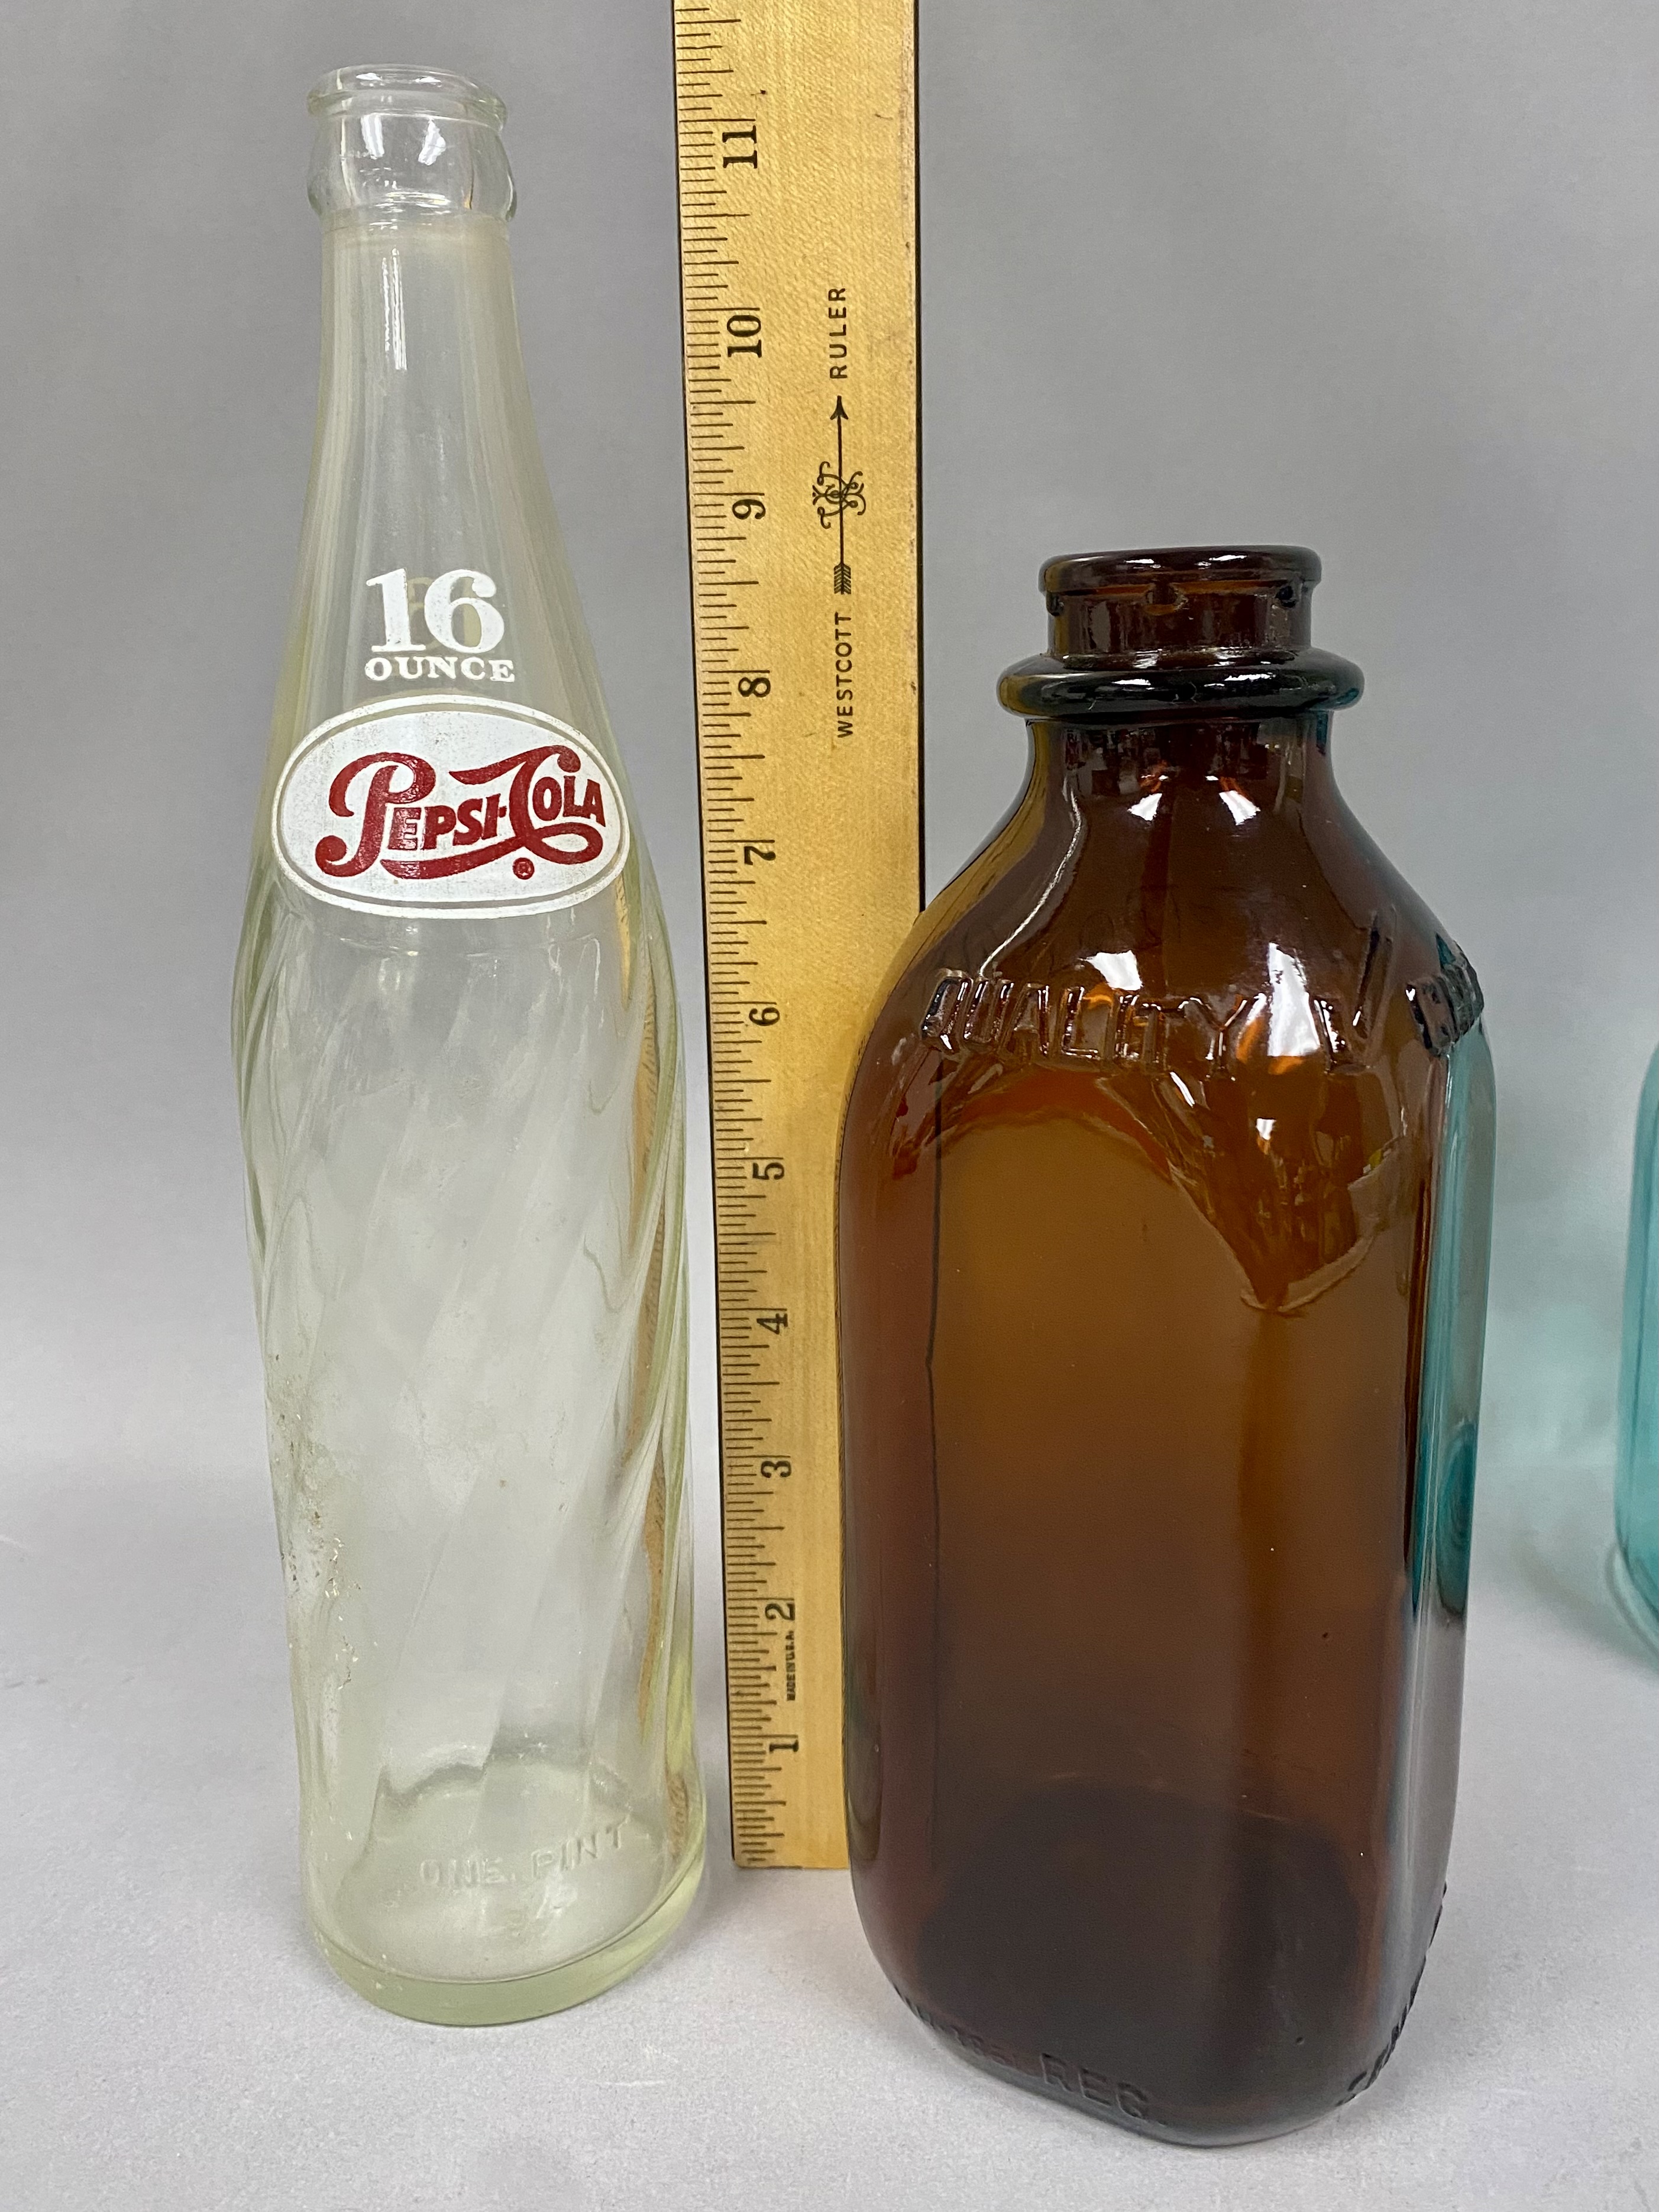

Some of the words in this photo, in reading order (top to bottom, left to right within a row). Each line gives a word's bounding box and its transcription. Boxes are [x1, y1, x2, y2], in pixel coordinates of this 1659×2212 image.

[722, 125, 758, 169] 11
[726, 314, 762, 358] 10
[828, 287, 848, 379] RULER
[732, 499, 766, 520] 9
[366, 568, 505, 654] 16
[364, 656, 515, 683] OUNCE
[835, 612, 853, 738] WESTCOTT
[738, 677, 771, 698] 8
[743, 846, 776, 866] 7
[749, 1007, 781, 1027] 6
[752, 1162, 785, 1181] 5
[756, 1313, 788, 1335] 4
[760, 1460, 791, 1479] 3
[765, 1603, 795, 1621] 2
[786, 1673, 795, 1701] MADE
[769, 1739, 799, 1752] 1
[532, 1817, 630, 1880] PINT
